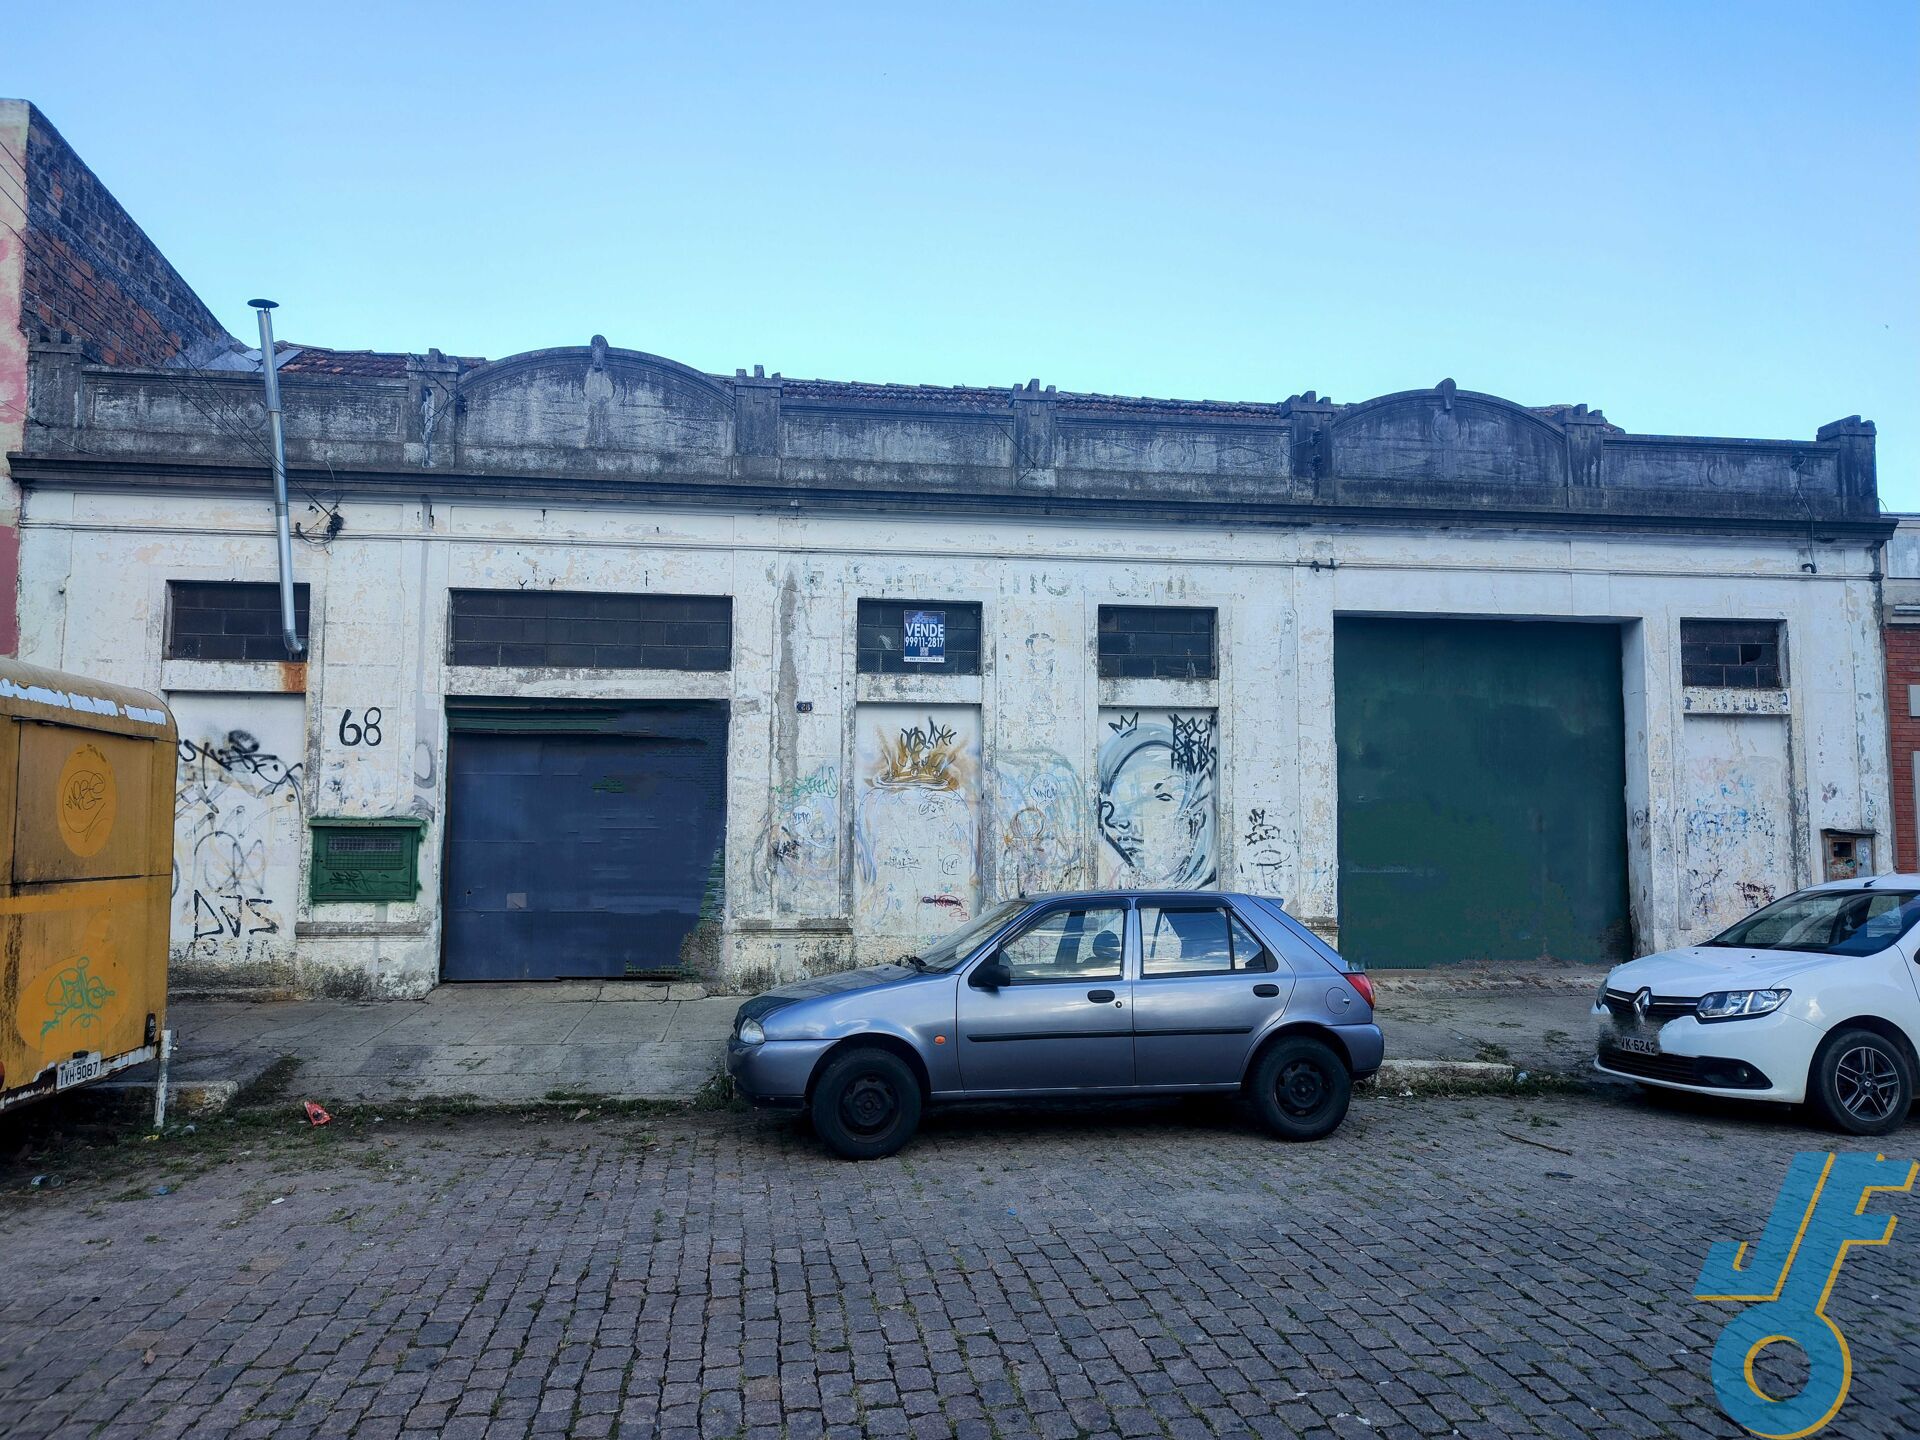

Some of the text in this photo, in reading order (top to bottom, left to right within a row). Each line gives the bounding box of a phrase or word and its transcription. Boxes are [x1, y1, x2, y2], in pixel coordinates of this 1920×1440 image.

[905, 623, 944, 637] VENDE
[905, 637, 944, 648] 99911-2817
[339, 707, 382, 746] 68
